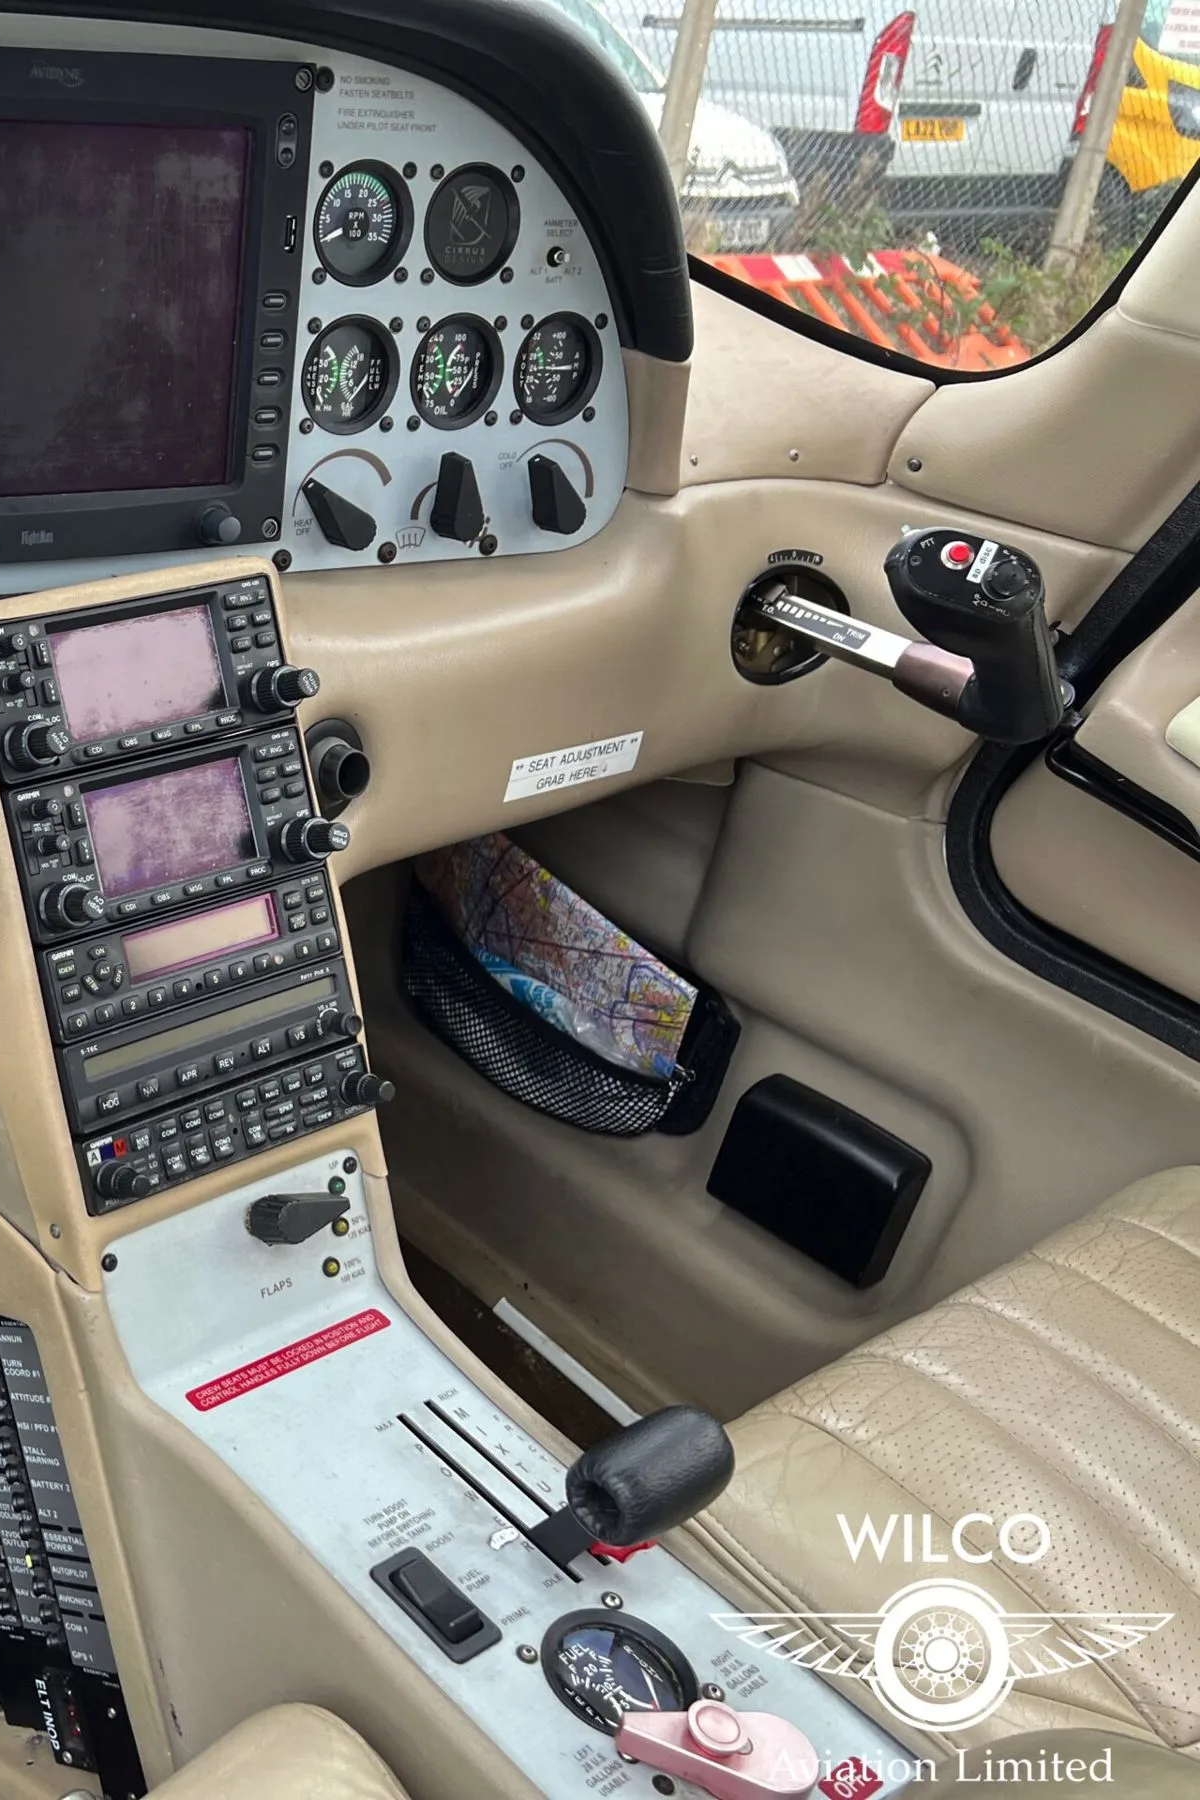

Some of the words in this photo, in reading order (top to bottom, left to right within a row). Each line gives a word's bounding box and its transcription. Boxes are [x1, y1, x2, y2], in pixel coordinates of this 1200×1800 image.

[340, 76, 353, 85] NO
[354, 76, 390, 86] SMOKING
[340, 89, 371, 99] FASTEN
[372, 90, 414, 100] SEATBELTS
[338, 108, 356, 118] FIRE
[358, 109, 414, 119] EXTINGUISHER
[338, 122, 365, 131] UNDER
[367, 123, 388, 132] PILOT
[390, 123, 409, 132] SEAT
[411, 124, 437, 133] FRONT
[344, 189, 352, 198] 15
[359, 189, 368, 198] 20
[349, 211, 365, 219] RPM
[544, 219, 578, 229] AMMETER
[547, 228, 573, 238] SELECT
[434, 406, 448, 415] OIL
[294, 519, 314, 528] HEAT
[920, 537, 935, 550] PTT
[980, 547, 993, 564] disc
[846, 627, 866, 641] TRIM
[528, 756, 556, 773] SEAT
[560, 739, 626, 765] ADJUSTMENT
[536, 773, 565, 790] GRAB
[569, 766, 598, 783] HERE
[294, 1031, 305, 1041] VS
[256, 1042, 271, 1054] ALT
[218, 1056, 235, 1069] REV
[181, 1069, 198, 1081] APR
[143, 1083, 159, 1095] NAV
[313, 1090, 328, 1100] PILOT
[103, 1096, 120, 1111] HDG
[260, 1277, 293, 1299] FLAPS
[2, 1358, 23, 1368] TURN
[195, 1383, 222, 1400] CREW
[221, 1370, 249, 1389] SEATS
[249, 1361, 271, 1377] MUST
[272, 1354, 282, 1365] BE
[282, 1342, 314, 1360] LOCKED
[314, 1336, 323, 1347] IN
[322, 1322, 358, 1341] POSITION
[358, 1313, 375, 1326] AND
[200, 1386, 241, 1408] CONTROL
[240, 1368, 278, 1390] HANDLES
[276, 1358, 301, 1375] FULLY
[300, 1345, 327, 1362] DOWN
[325, 1332, 357, 1351] BEFORE
[356, 1319, 383, 1336] FLIGHT
[4, 1367, 31, 1377] COORD
[11, 1393, 45, 1403] ATTITUDE
[438, 1388, 458, 1402] RICH
[375, 1421, 394, 1434] MAX
[23, 1446, 46, 1456] STALL
[25, 1456, 60, 1466] WARNING
[31, 1479, 64, 1490] BATTERY
[38, 1508, 52, 1517] ALT
[383, 1499, 408, 1516] BOOST
[395, 1508, 436, 1535] SWITCHING
[44, 1532, 84, 1545] ESSENTIAL
[408, 1523, 432, 1541] TANKS
[46, 1542, 74, 1553] POWER
[425, 1532, 455, 1552] BOOST
[52, 1566, 88, 1579] AUTOPILOT
[457, 1568, 482, 1585] FUEL
[466, 1574, 491, 1593] PUMP
[543, 1572, 565, 1589] IDLE
[59, 1594, 93, 1607] AVIONICS
[501, 1606, 530, 1627] PRIME
[65, 1622, 82, 1633] COM
[72, 1650, 88, 1661] GPS
[558, 1642, 590, 1665] FUEL
[710, 1649, 734, 1667] RIGHT
[725, 1664, 761, 1689] GALLONS
[739, 1674, 769, 1698] USABLE
[35, 1678, 51, 1710] ELT
[43, 1711, 60, 1751] INOP
[574, 1744, 593, 1762] LEFT
[585, 1761, 623, 1788] GALLONS
[598, 1773, 631, 1797] USABLE
